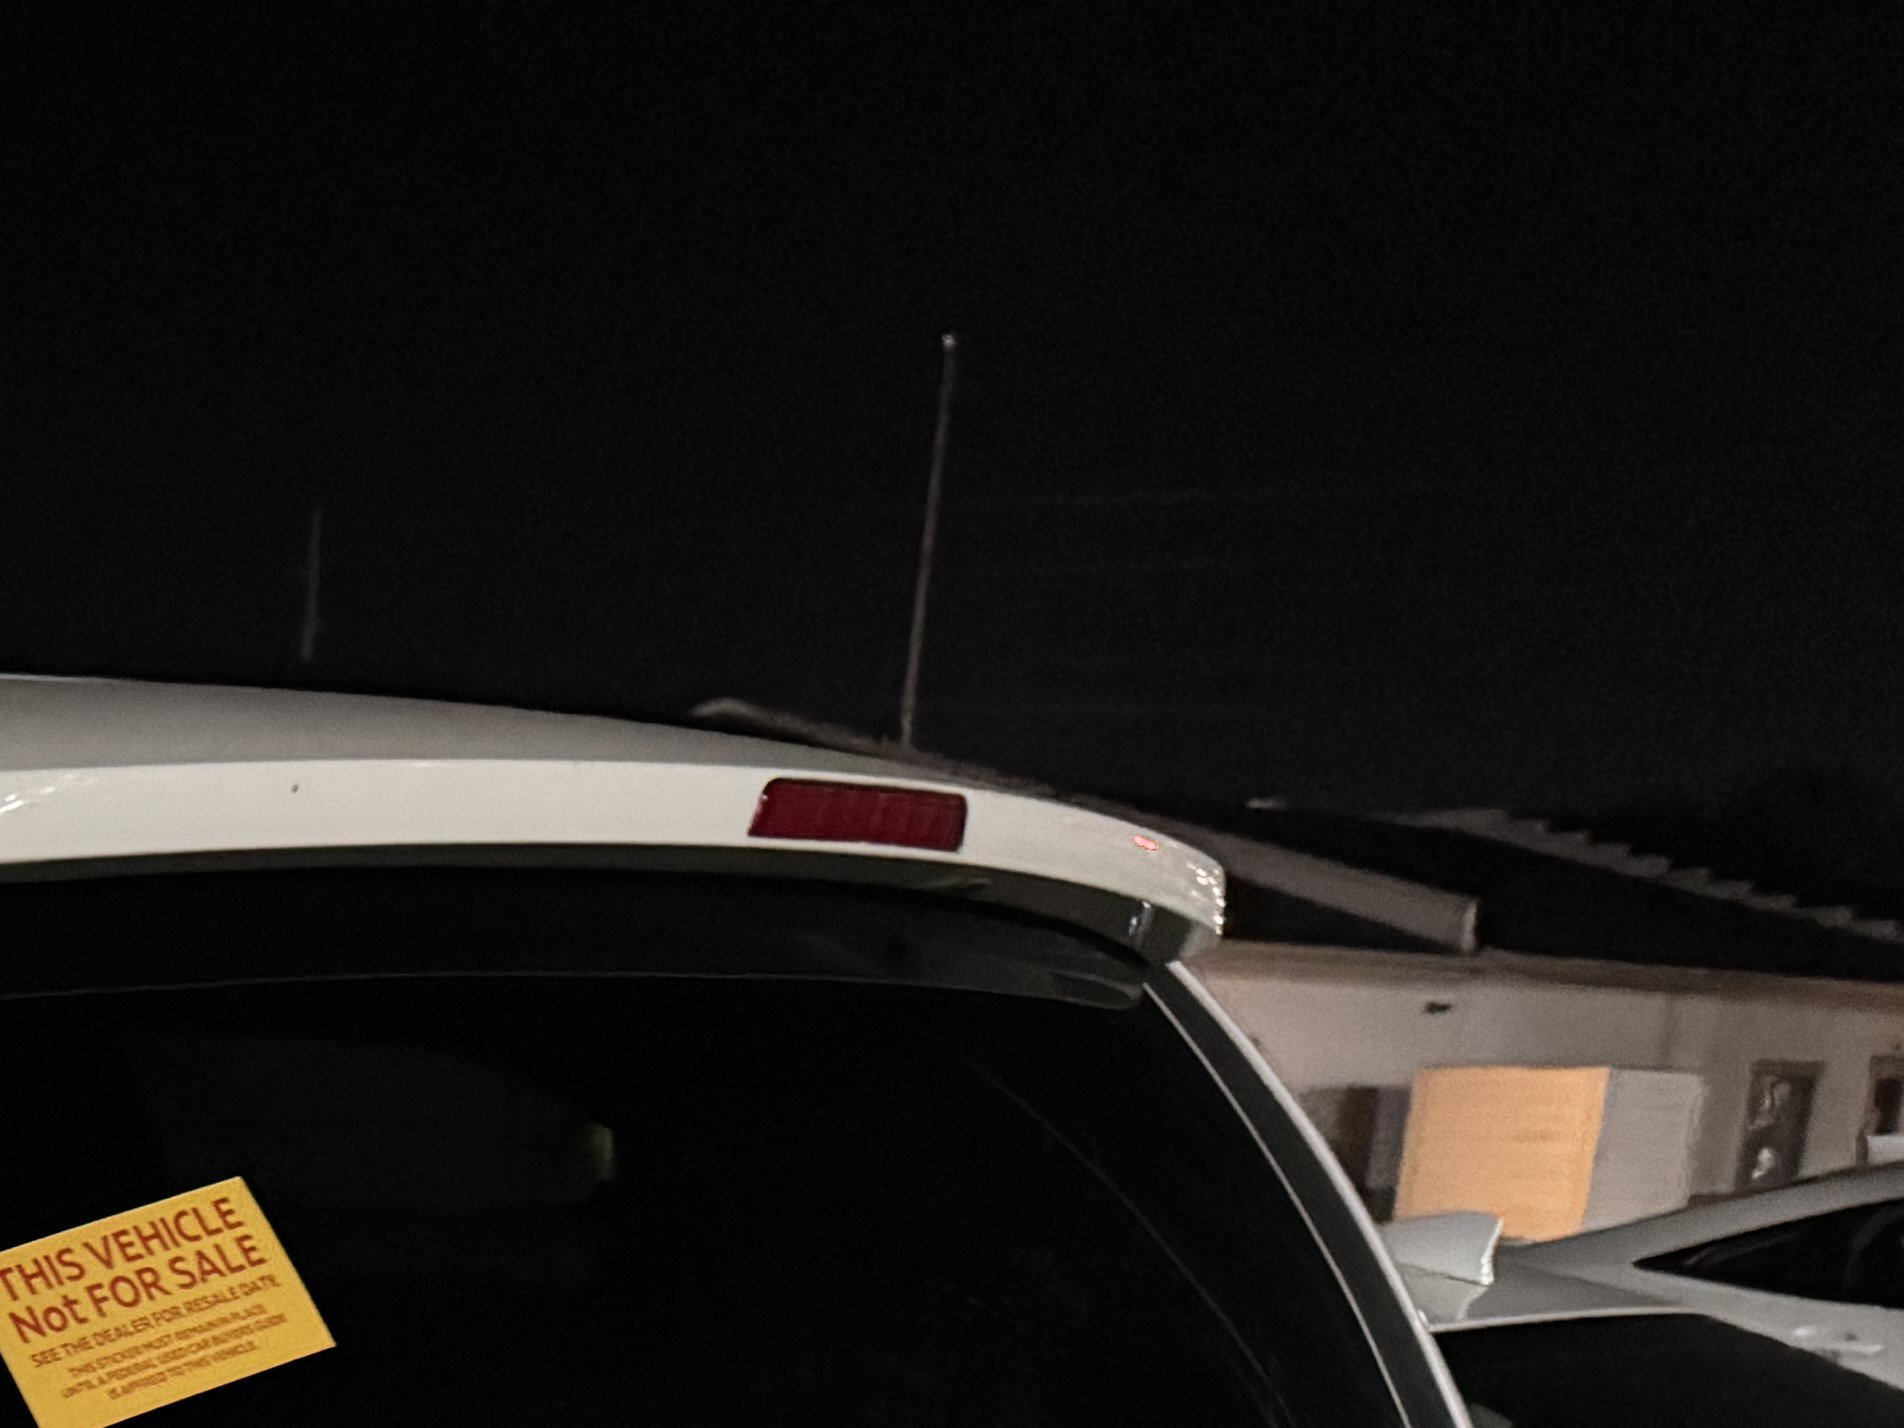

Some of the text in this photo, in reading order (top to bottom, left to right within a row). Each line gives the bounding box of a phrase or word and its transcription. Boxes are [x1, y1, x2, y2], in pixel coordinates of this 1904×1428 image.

[83, 1197, 243, 1268] VEHICLE
[8, 1234, 265, 1343] Not FOR SALE
[30, 1347, 62, 1367] SEE
[59, 1336, 94, 1356] THE
[150, 1305, 185, 1326] FOR
